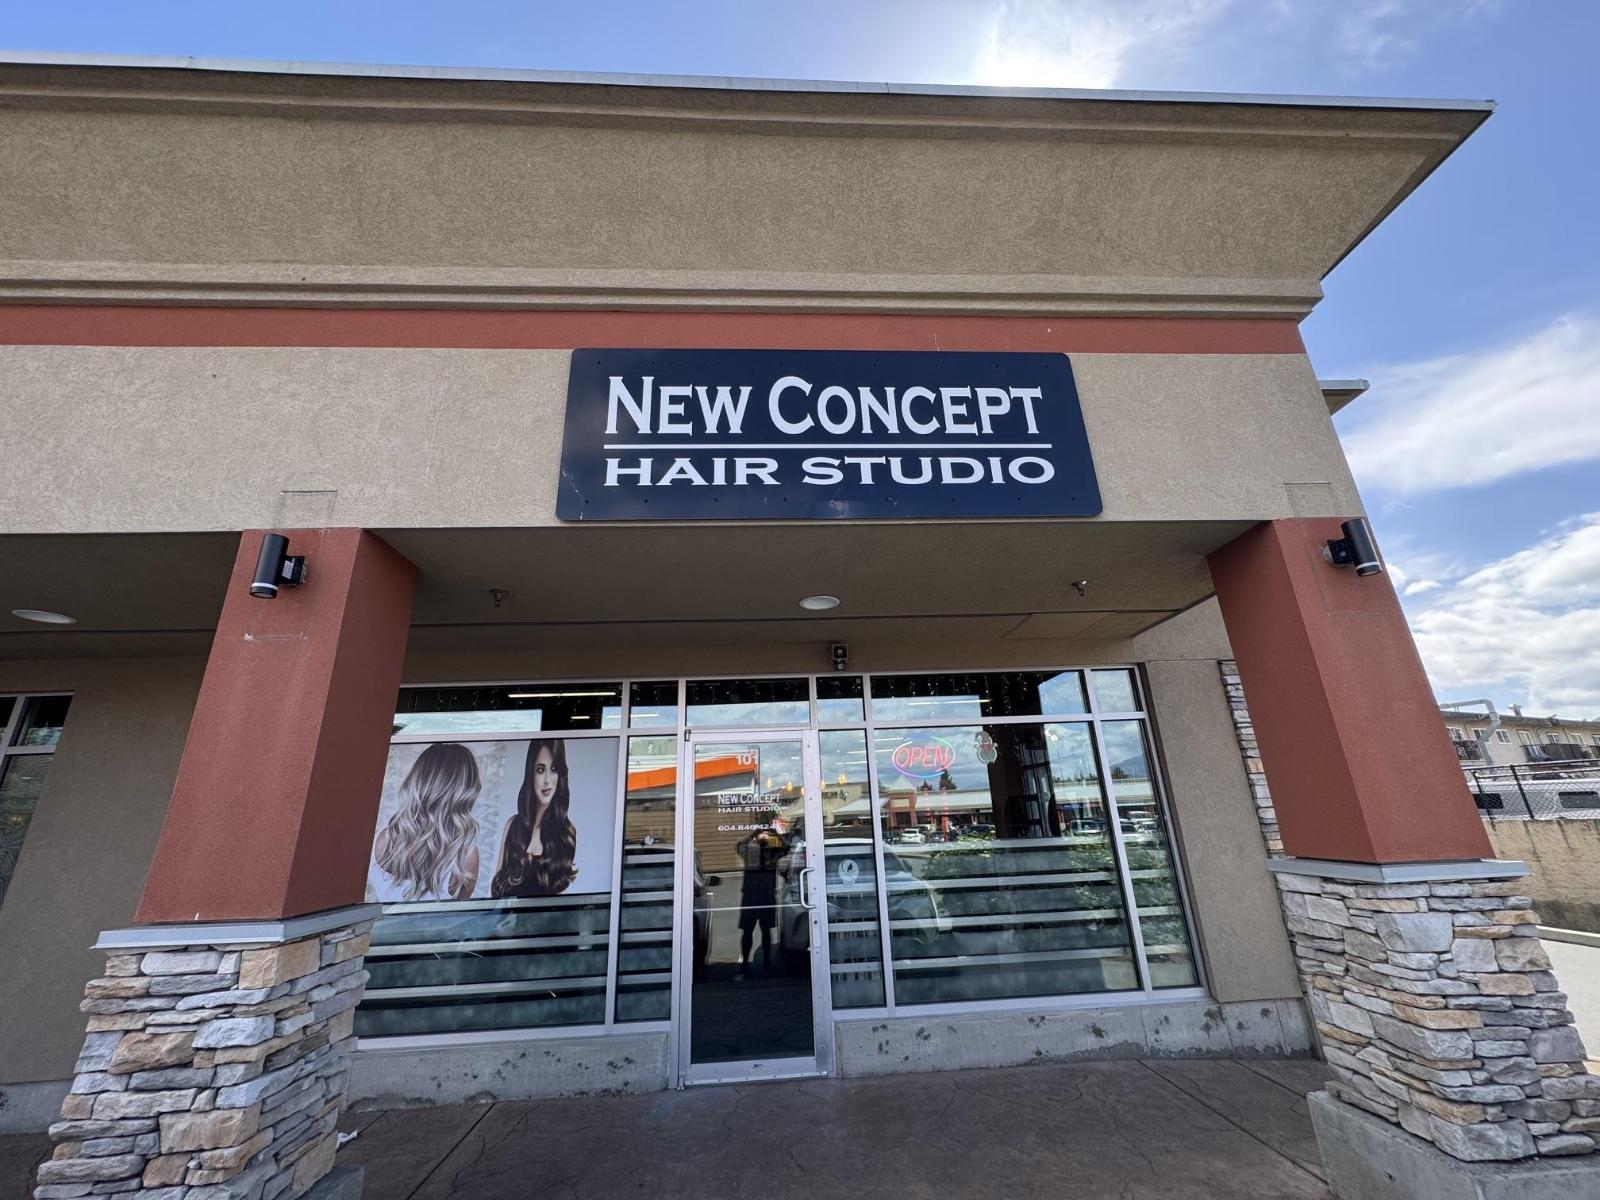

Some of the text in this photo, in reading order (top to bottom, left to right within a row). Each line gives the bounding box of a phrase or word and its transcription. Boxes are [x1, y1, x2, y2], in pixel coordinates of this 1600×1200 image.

[604, 376, 1043, 436] NEW CONCEPT
[604, 456, 1055, 486] HAIR STUDIO
[736, 752, 758, 765] 101
[895, 745, 949, 768] OPEN
[718, 793, 781, 805] NEW CONCEPT
[718, 804, 781, 814] HAIR STUDIO
